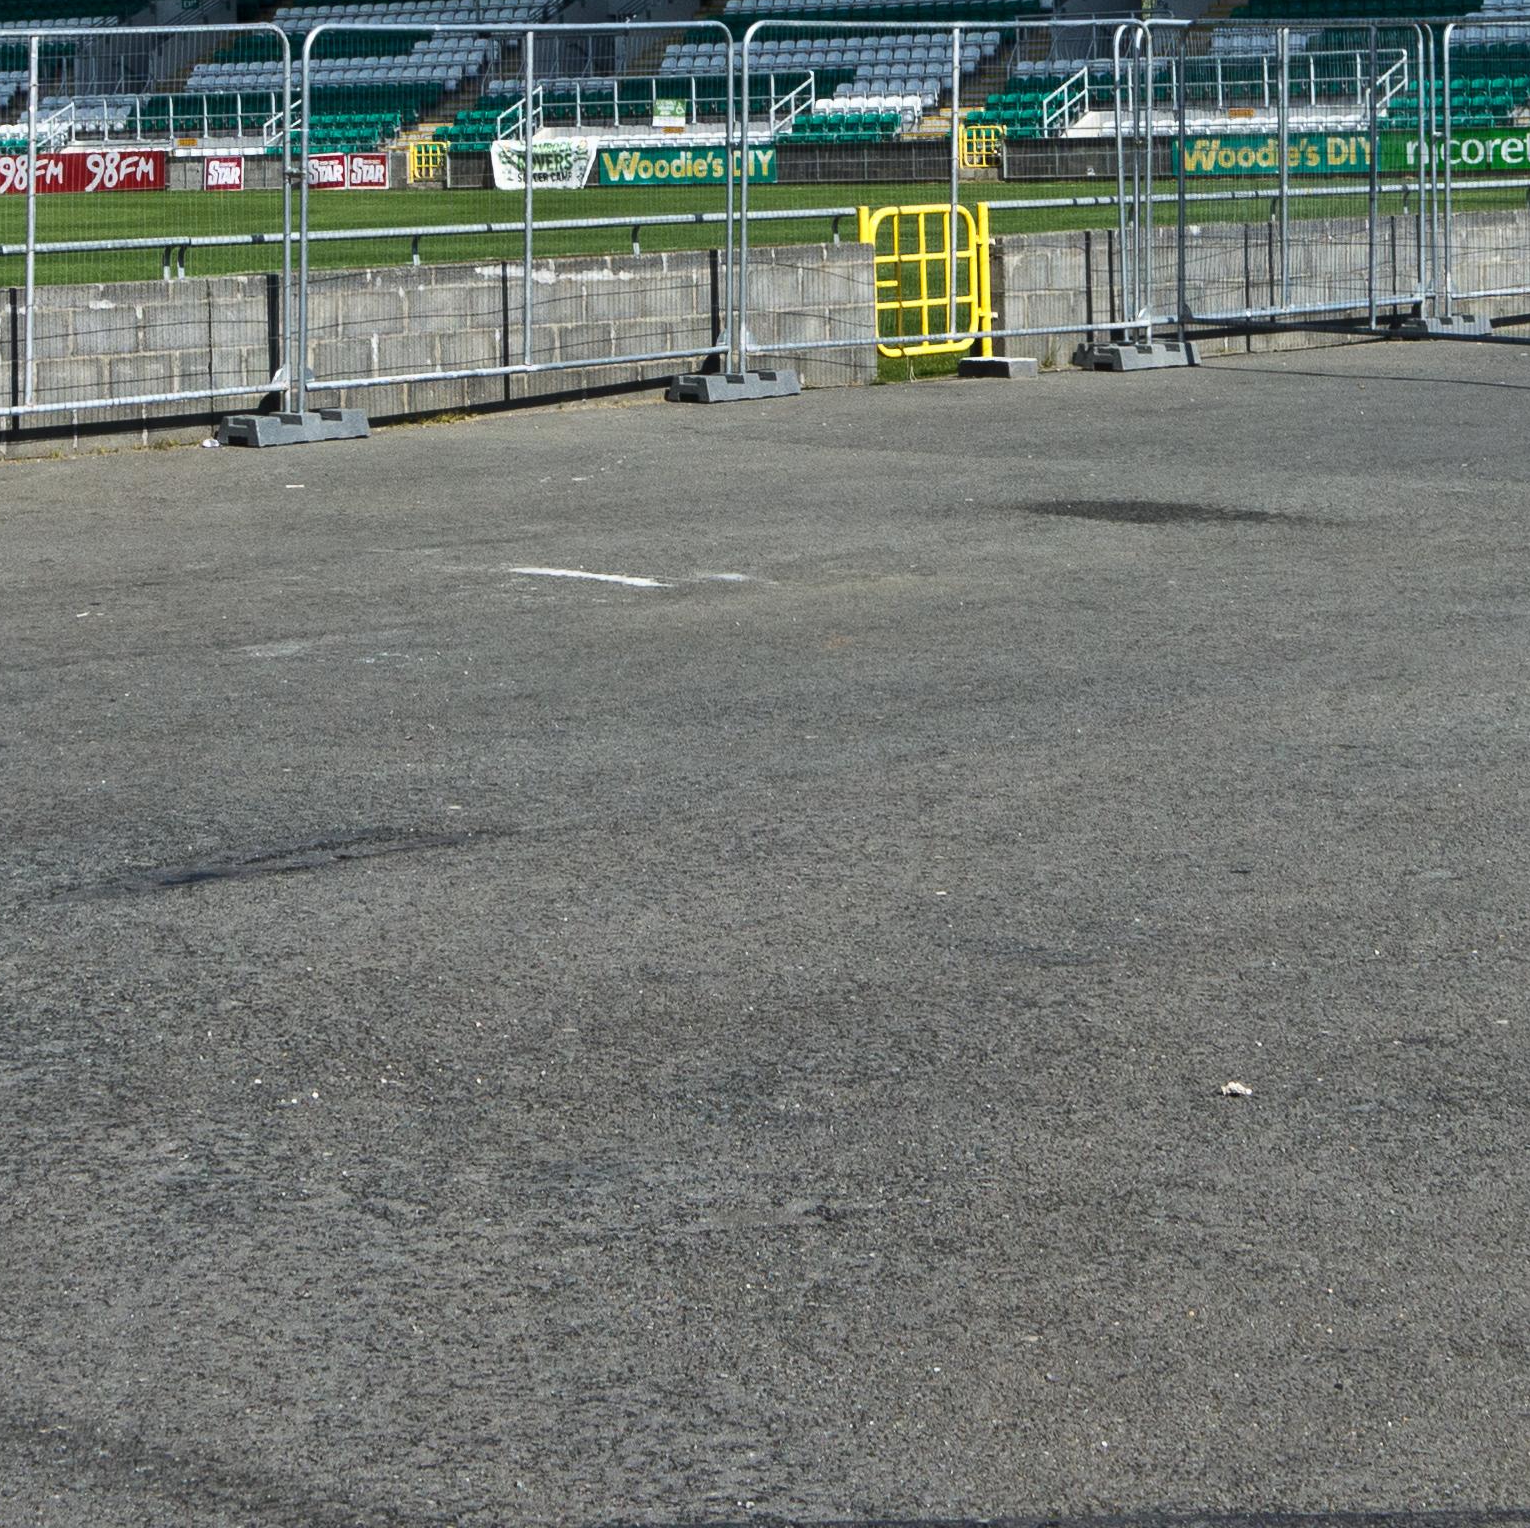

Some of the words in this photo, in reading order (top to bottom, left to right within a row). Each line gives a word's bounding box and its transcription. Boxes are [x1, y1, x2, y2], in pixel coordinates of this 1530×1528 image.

[601, 150, 724, 182] Woodie's
[1175, 137, 1321, 171] Woode's
[84, 152, 154, 192] 98FM
[207, 160, 241, 186] STAR
[307, 159, 343, 185] STAR
[351, 158, 384, 184] STAR
